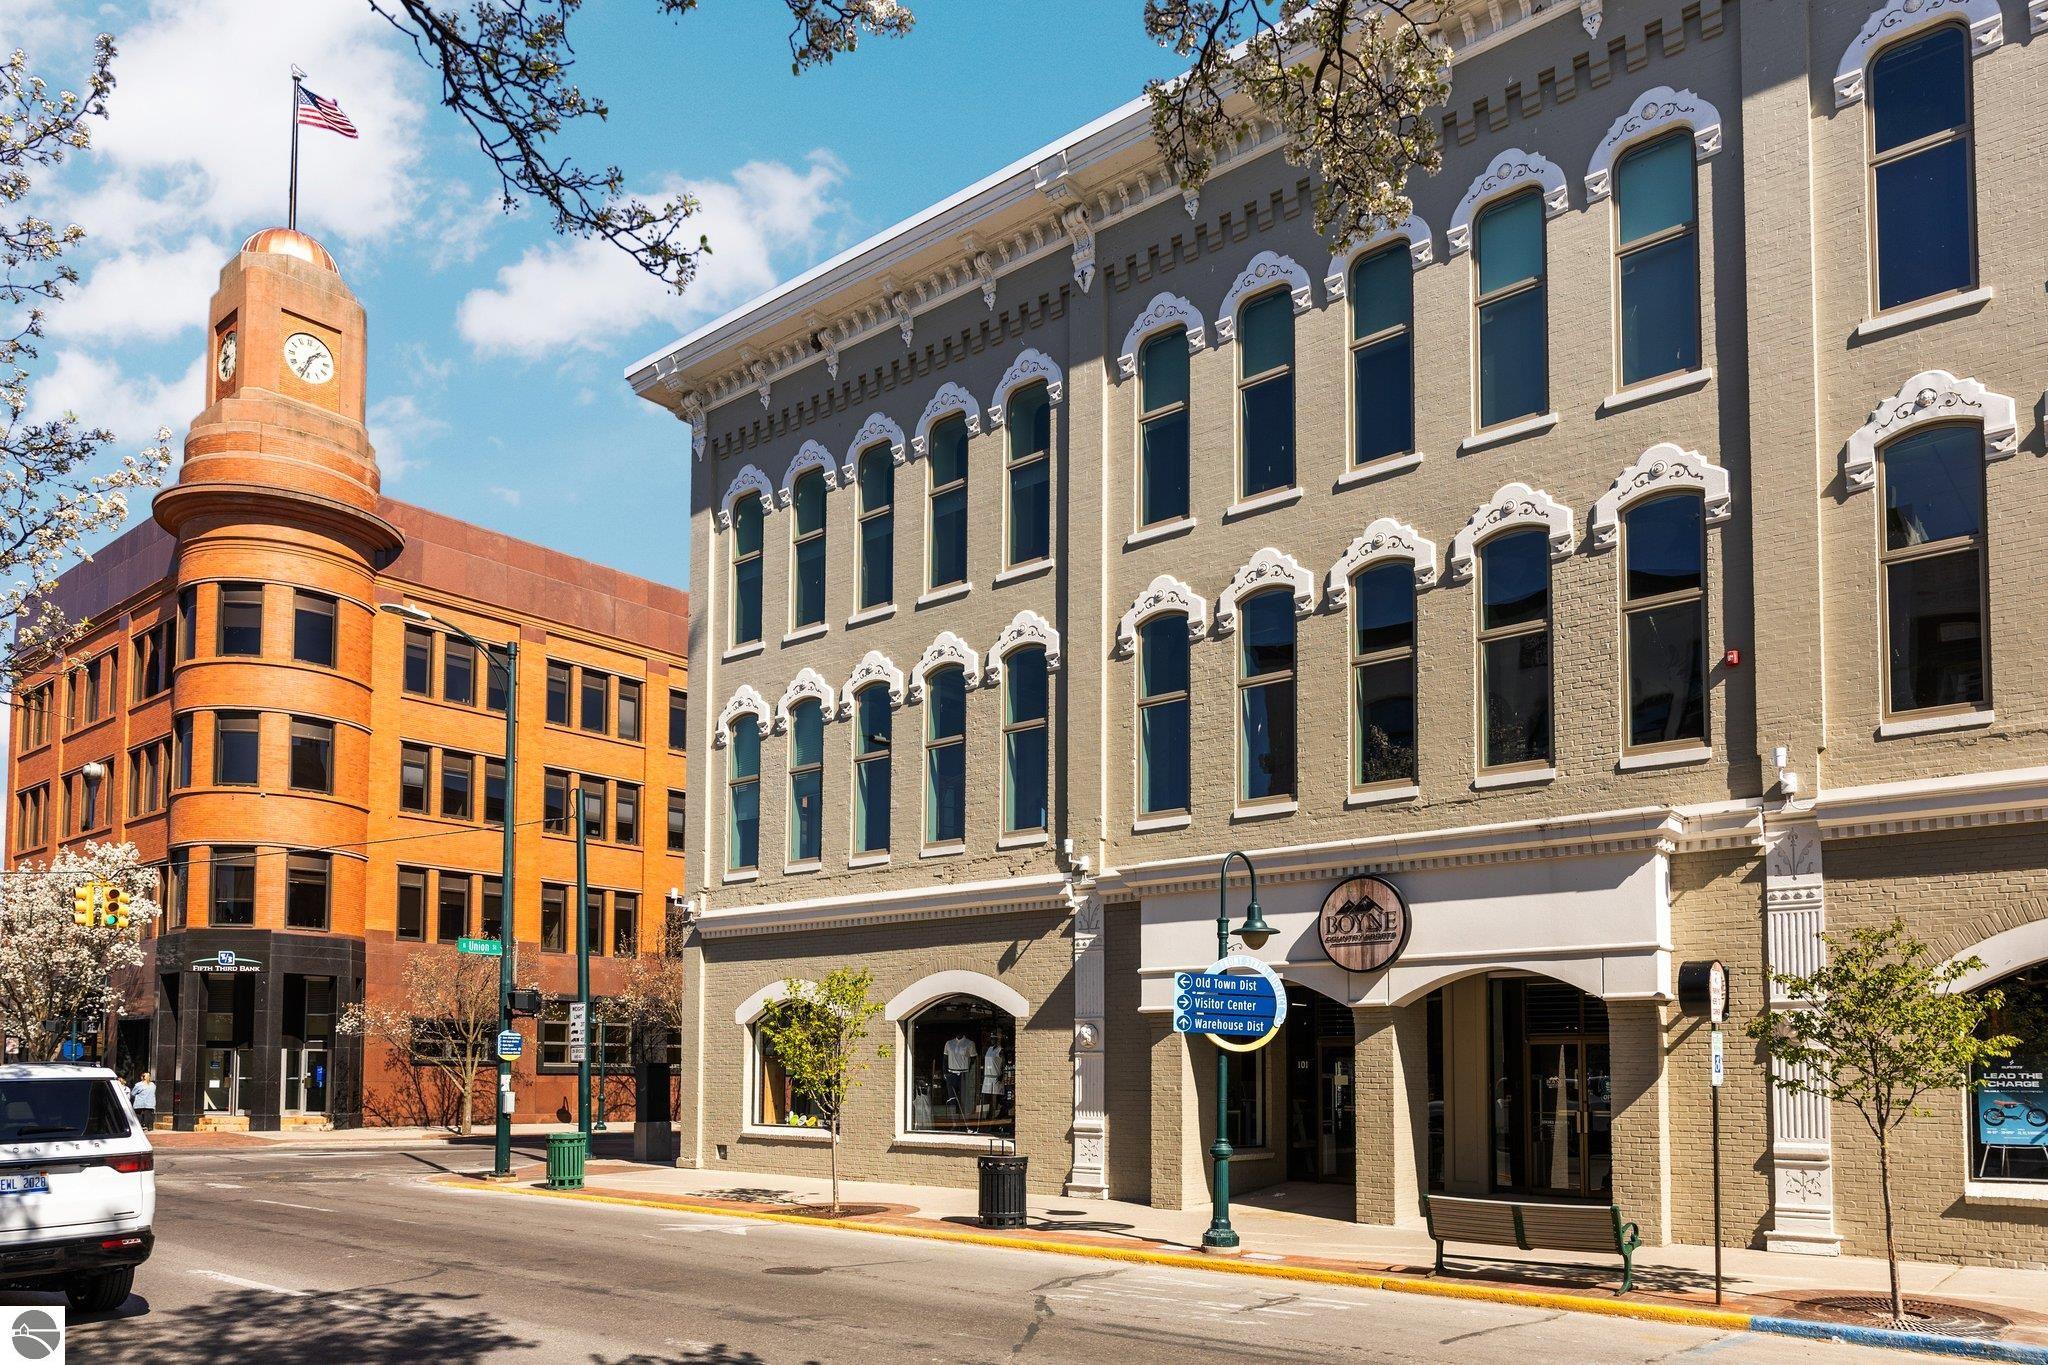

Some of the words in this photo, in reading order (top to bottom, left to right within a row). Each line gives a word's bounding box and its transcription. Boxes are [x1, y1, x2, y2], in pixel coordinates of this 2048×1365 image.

[1325, 911, 1397, 935] BOYNE
[1325, 934, 1363, 943] COUNTRY
[1364, 932, 1396, 940] SPORTS
[468, 941, 490, 951] Union
[1195, 977, 1211, 988] Old
[1214, 978, 1236, 990] Town
[1240, 979, 1257, 991] Dist
[1195, 997, 1224, 1010] Visitor
[1227, 999, 1257, 1011] Center
[1194, 1018, 1244, 1031] Warehouse
[1247, 1020, 1264, 1032] Dist
[1297, 1061, 1309, 1069] 101
[1983, 1072, 2016, 1080] LEAD
[2018, 1072, 2043, 1080] THE
[1988, 1080, 2040, 1088] CHARGE
[23, 1176, 46, 1188] 2028
